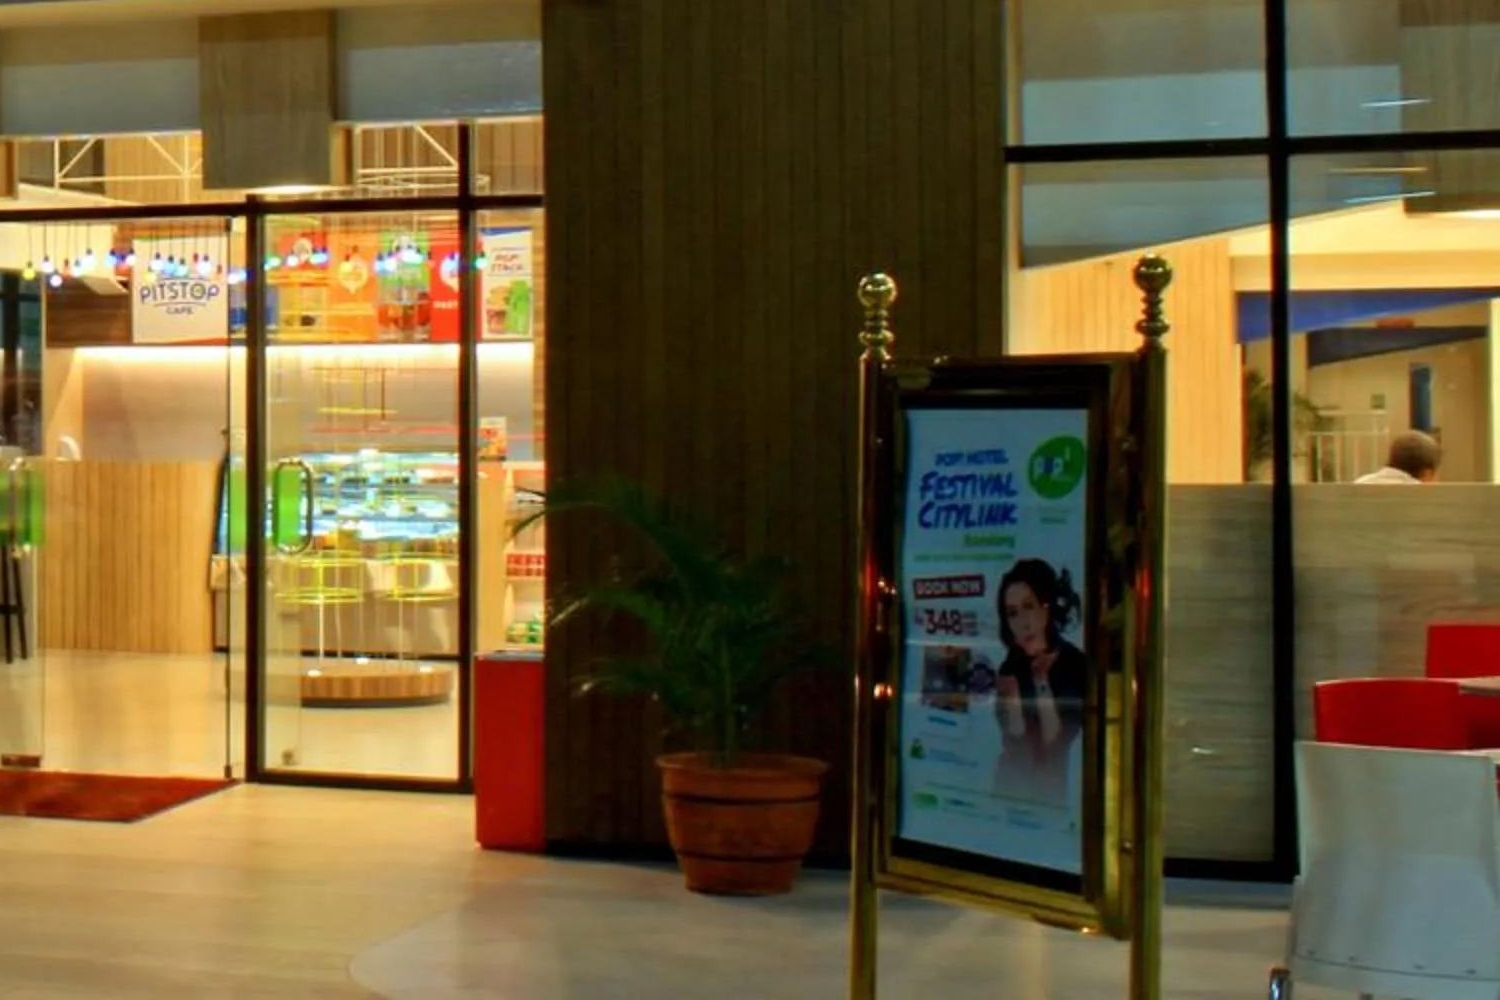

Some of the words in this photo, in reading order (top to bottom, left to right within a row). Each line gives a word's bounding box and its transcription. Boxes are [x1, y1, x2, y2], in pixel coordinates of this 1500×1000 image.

[140, 281, 221, 304] PITSTOP
[919, 471, 1018, 499] FESTIVAL
[918, 501, 1018, 529] CITYLINK
[924, 608, 963, 635] 348
